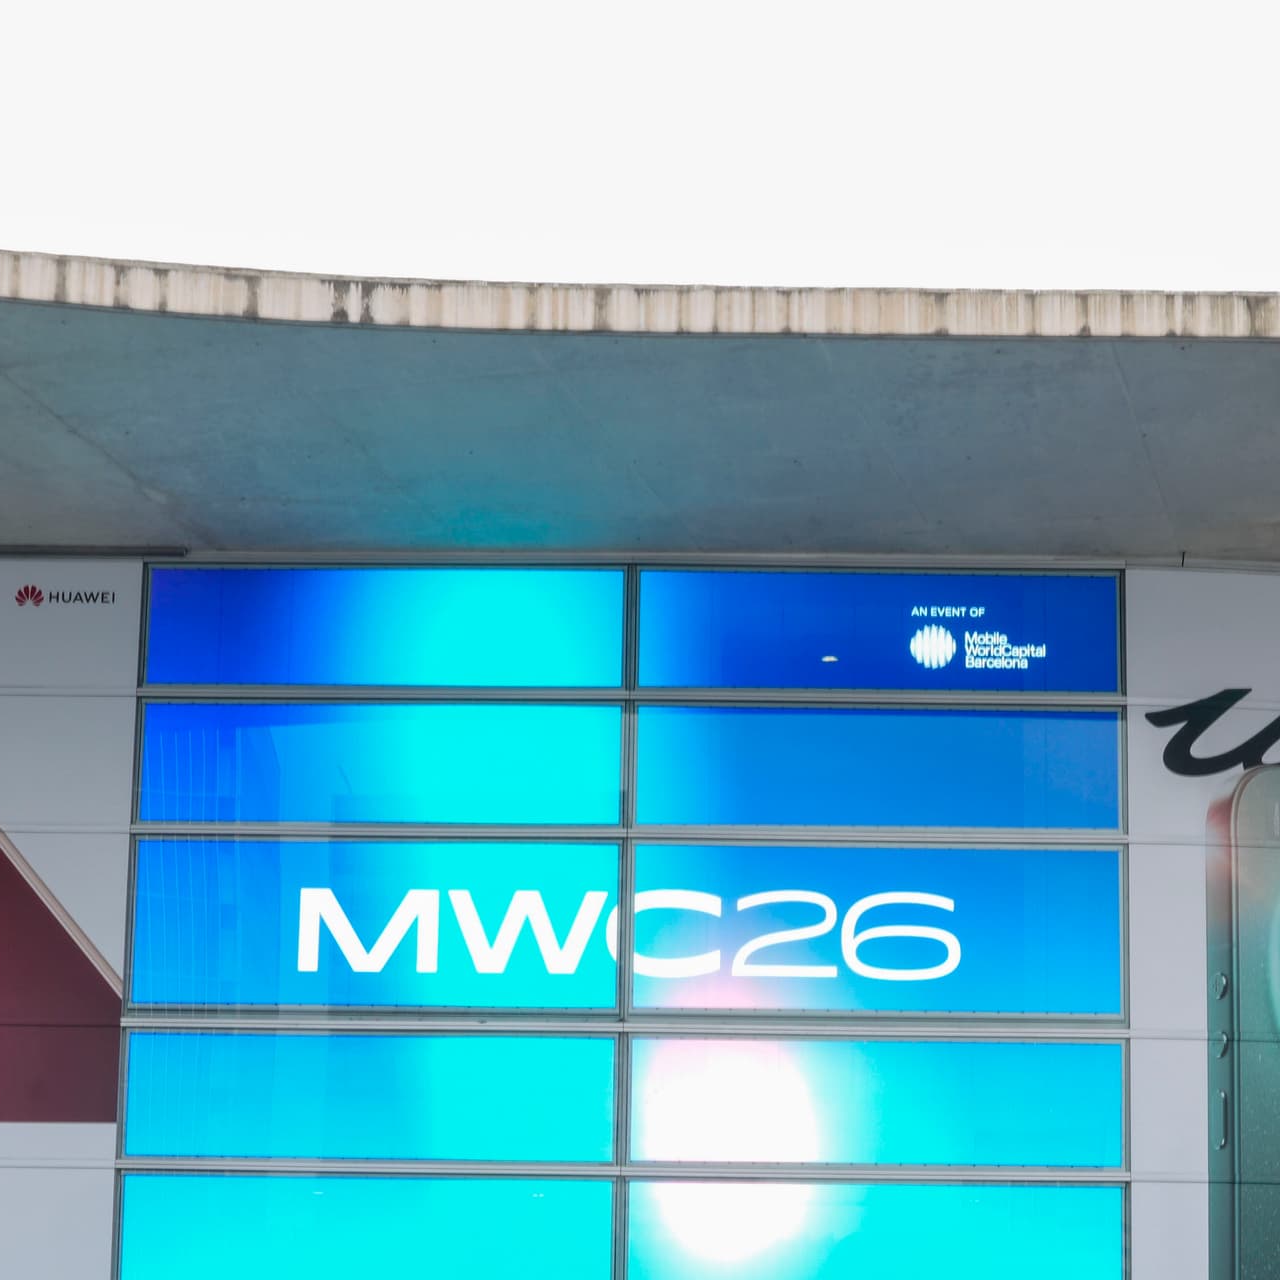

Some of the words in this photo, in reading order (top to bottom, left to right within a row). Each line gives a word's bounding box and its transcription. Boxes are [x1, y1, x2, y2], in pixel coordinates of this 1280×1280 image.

[49, 592, 115, 604] HUAWEI
[911, 607, 928, 617] AN
[931, 607, 966, 617] EVENT
[969, 607, 985, 617] OF
[965, 631, 1008, 645] Mobile
[965, 643, 1046, 658] WorldCapital
[965, 655, 1028, 669] Barcelona
[297, 887, 962, 981] MWC26
